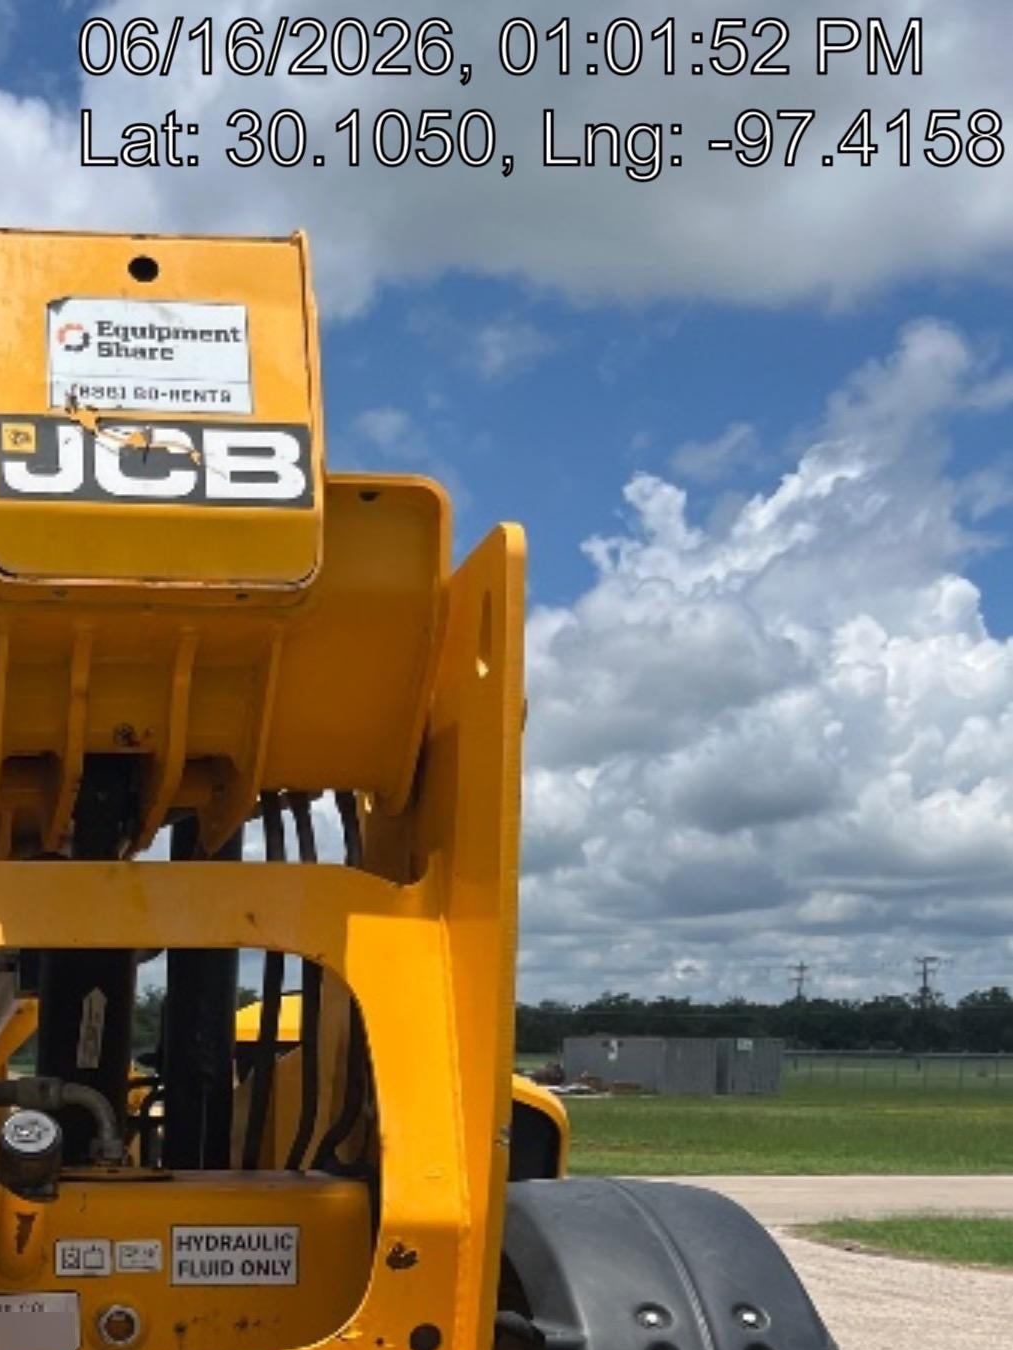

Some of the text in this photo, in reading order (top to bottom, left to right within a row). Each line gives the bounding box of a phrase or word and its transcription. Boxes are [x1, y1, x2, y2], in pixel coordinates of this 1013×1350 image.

[95, 320, 242, 343] Equipment
[96, 341, 175, 361] Share
[3, 425, 307, 500] JCB
[176, 1231, 294, 1252] HYDRAULIC
[177, 1258, 292, 1278] FLUID ONLY
